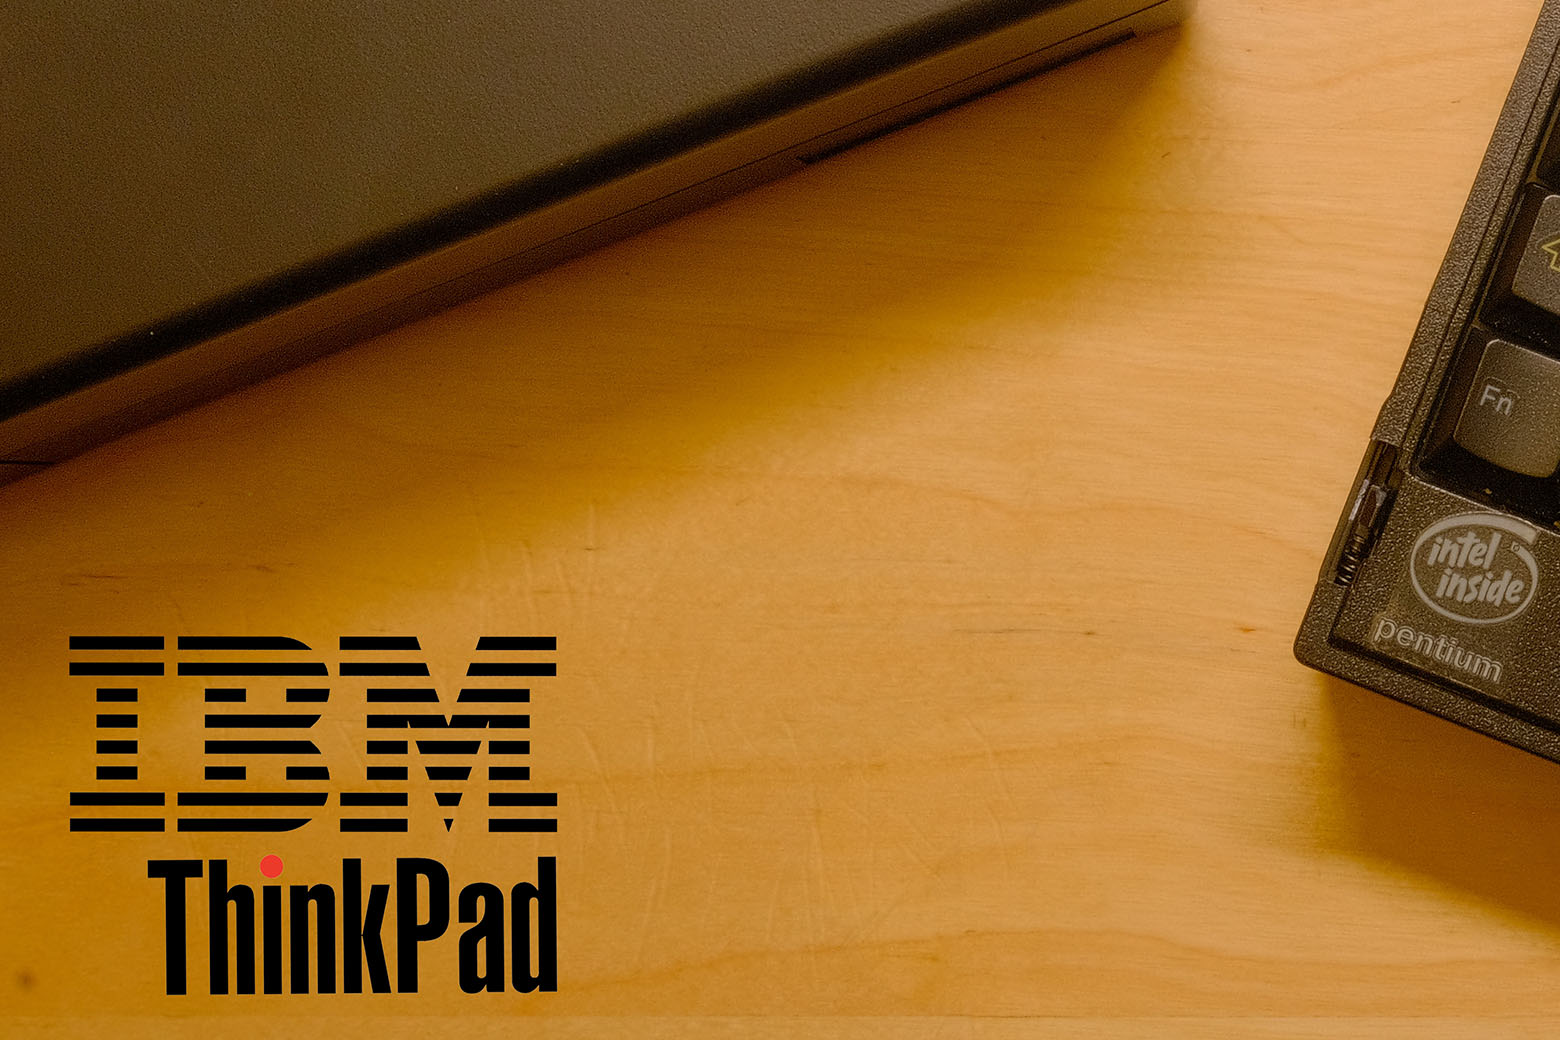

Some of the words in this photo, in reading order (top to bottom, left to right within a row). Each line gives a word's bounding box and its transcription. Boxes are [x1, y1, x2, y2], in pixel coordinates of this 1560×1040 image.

[1480, 385, 1513, 415] Fn
[1427, 531, 1502, 569] intel
[1434, 567, 1526, 608] inside
[1373, 616, 1503, 684] pentium
